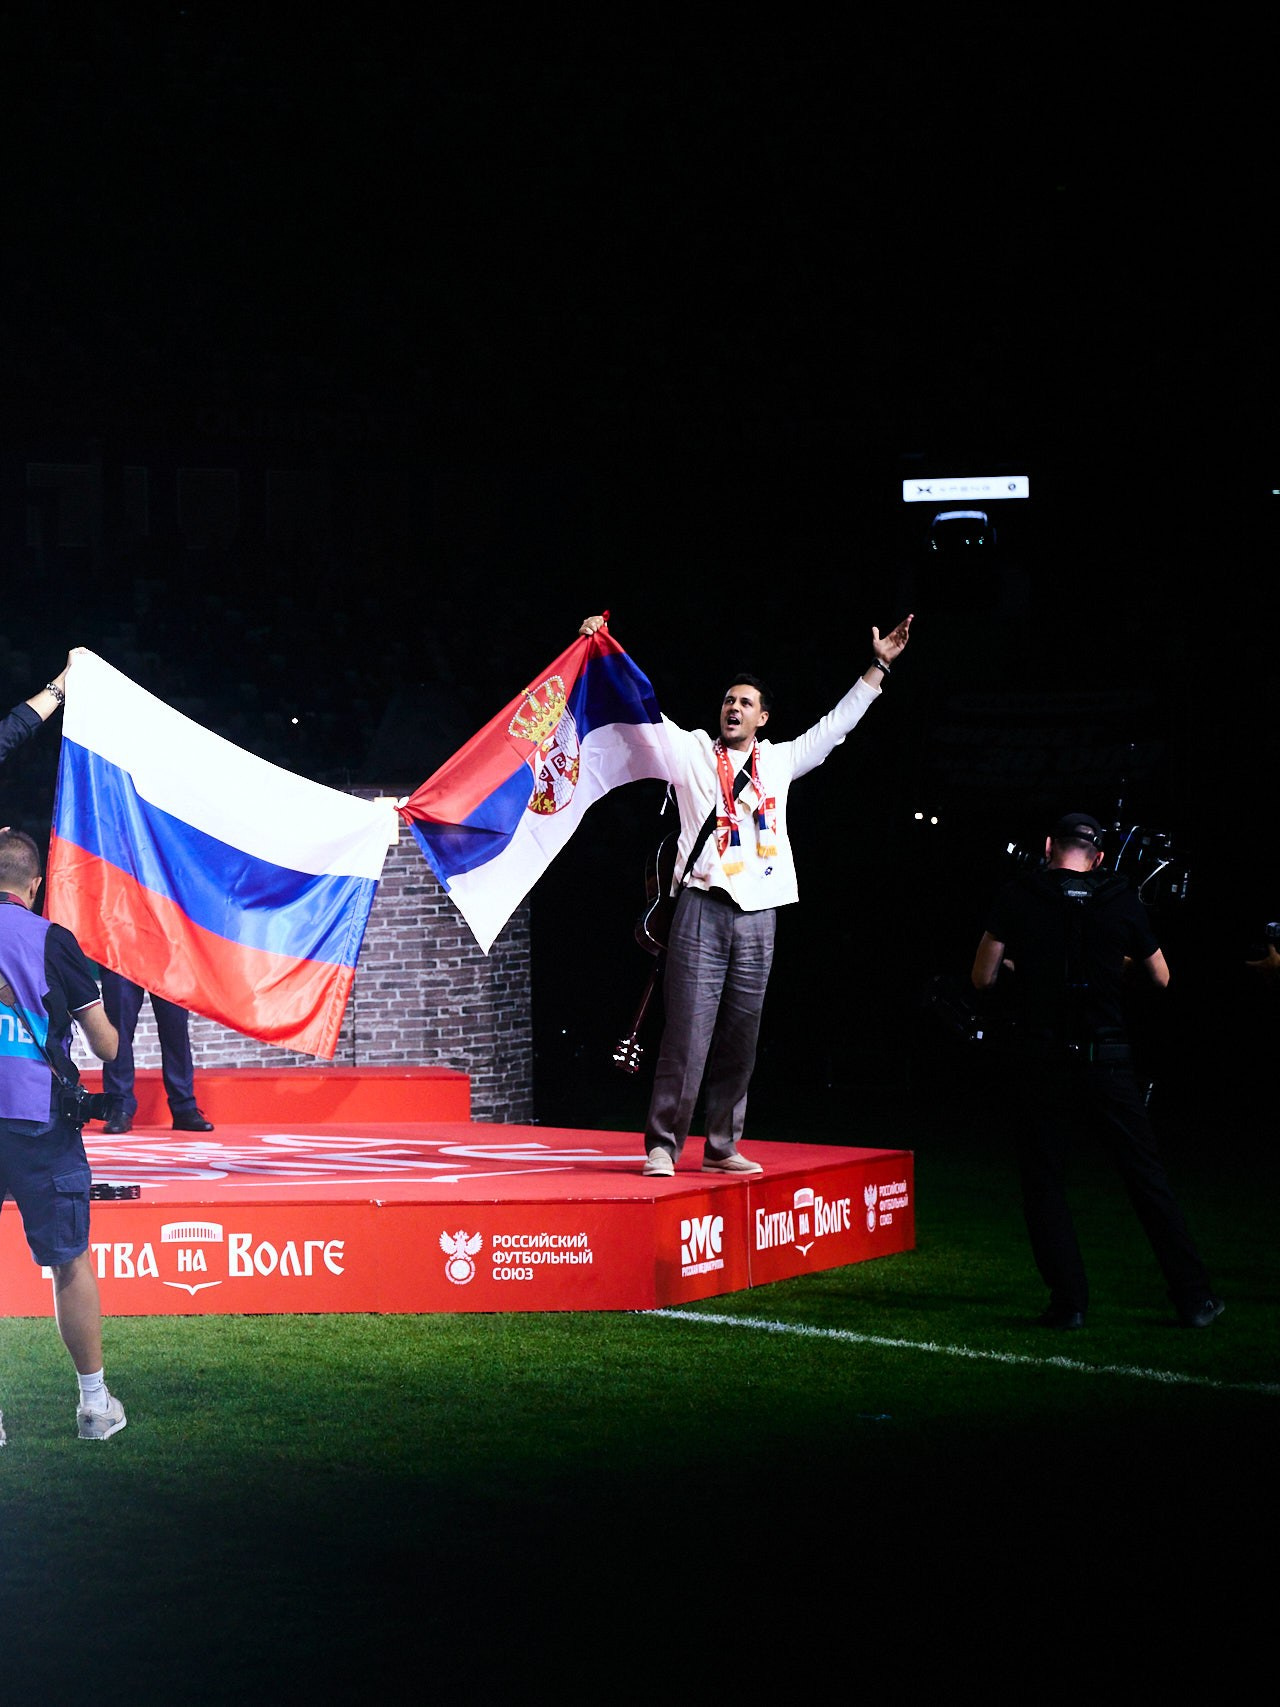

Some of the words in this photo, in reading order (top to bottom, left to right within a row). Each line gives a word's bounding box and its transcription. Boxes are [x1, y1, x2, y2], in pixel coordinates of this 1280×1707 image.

[492, 1232, 588, 1248] РОССИЙСКИЙ
[680, 1214, 724, 1266] RMG
[492, 1248, 593, 1264] ФУТБОЛЬНЫЙ
[492, 1266, 534, 1281] СОЮЗ
